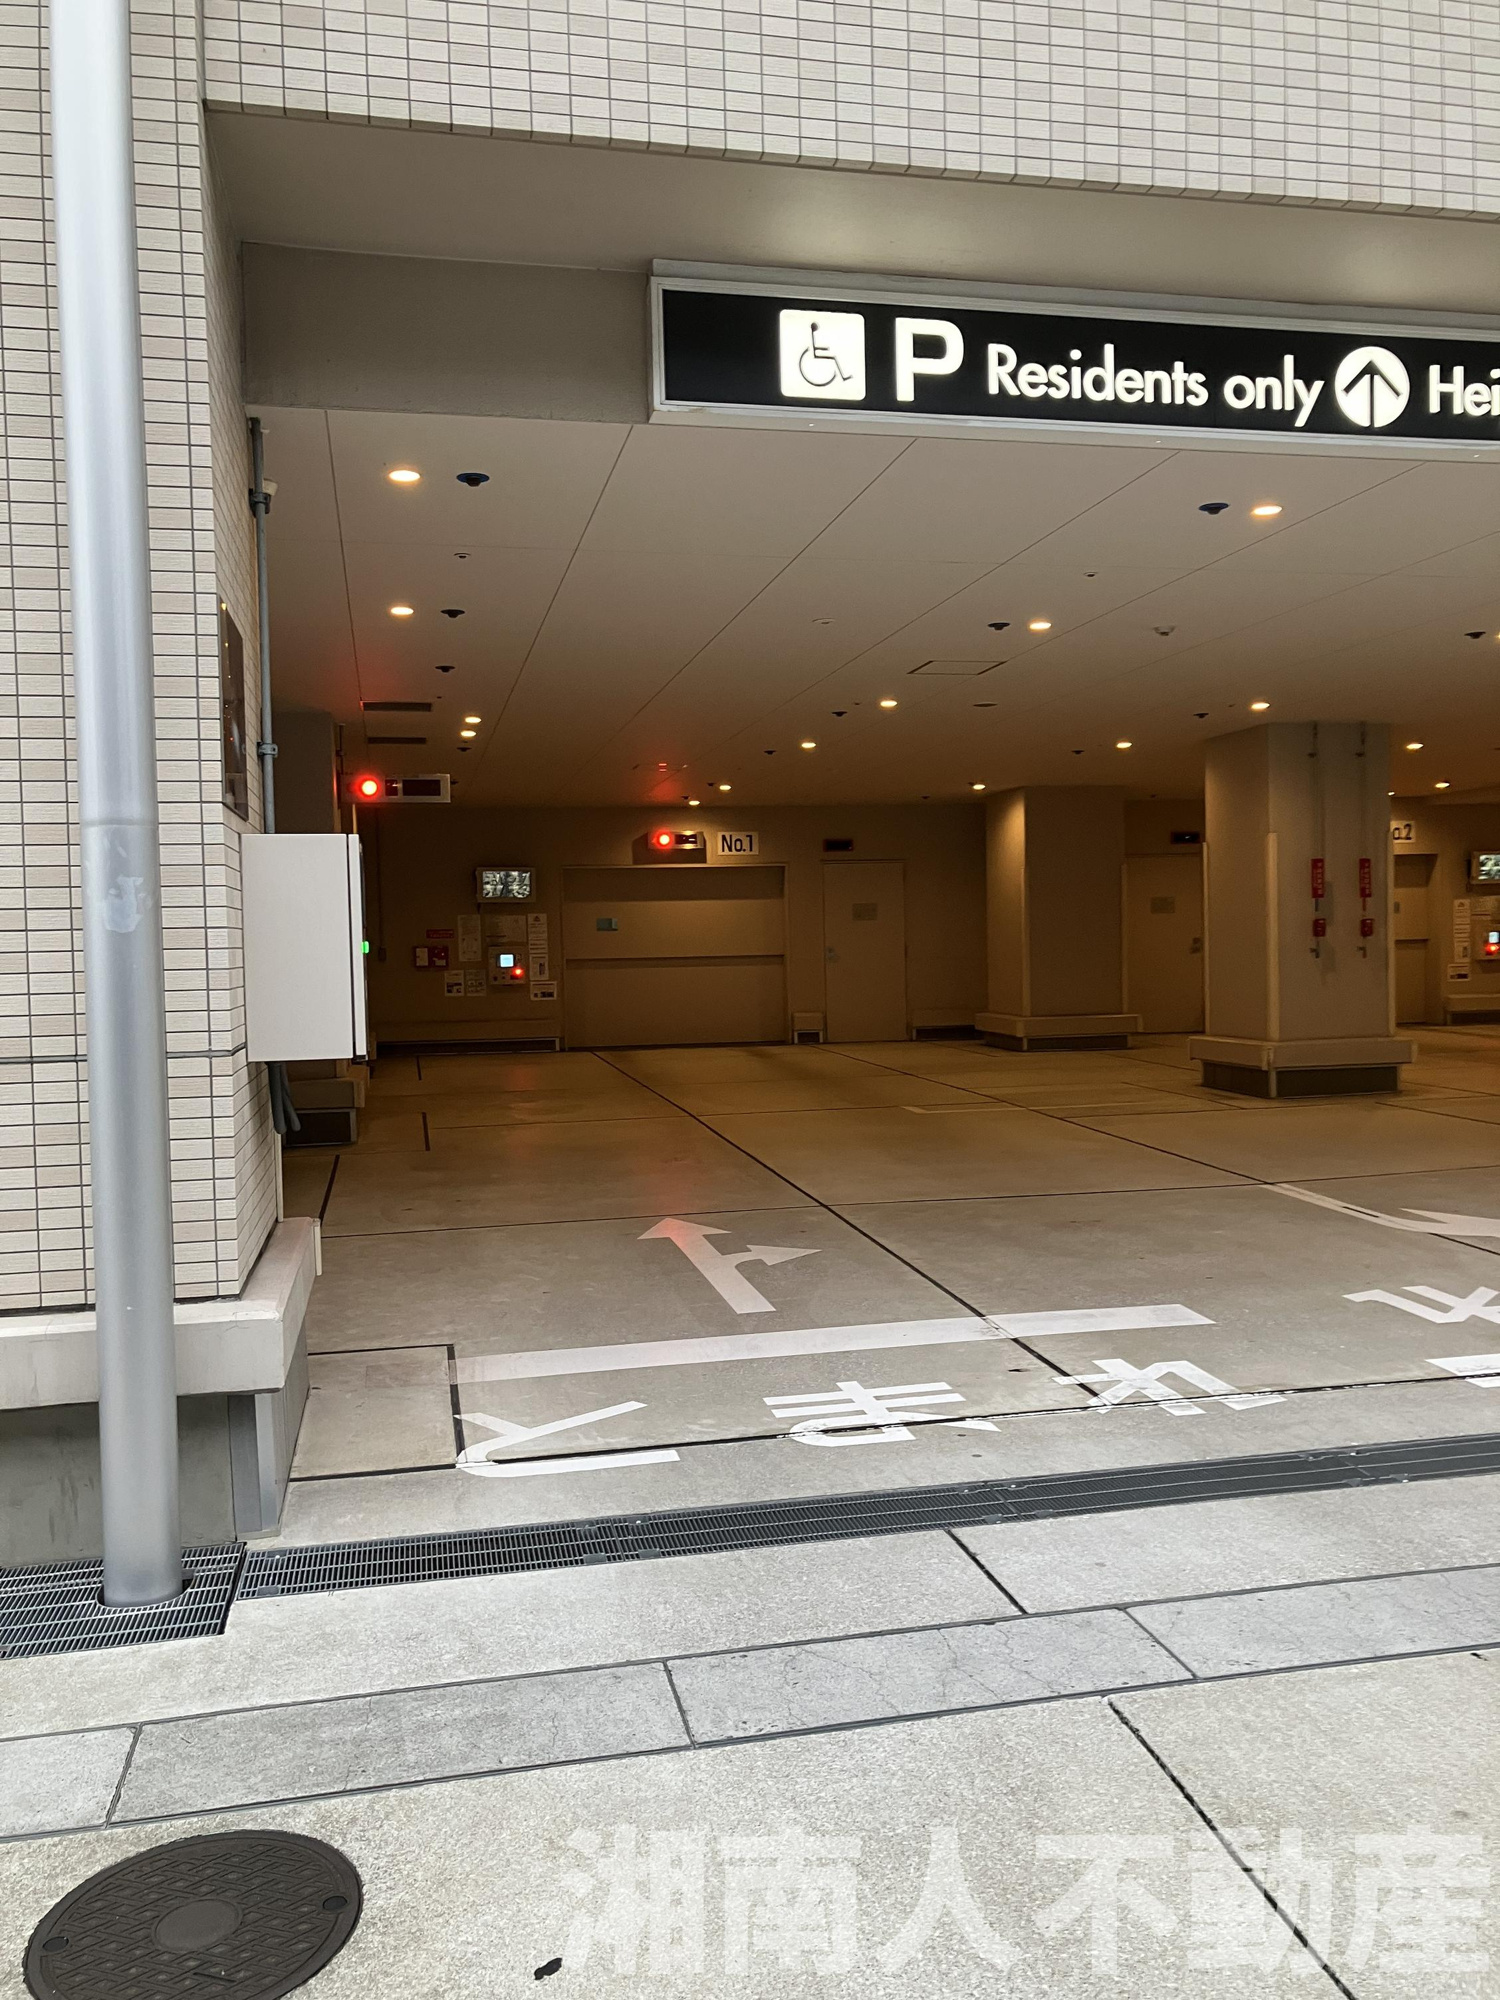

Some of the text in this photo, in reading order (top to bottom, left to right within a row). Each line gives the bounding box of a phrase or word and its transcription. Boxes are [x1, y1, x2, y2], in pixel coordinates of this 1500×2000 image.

[895, 318, 965, 402] P
[988, 343, 1208, 407] Residents
[1224, 354, 1325, 428] only
[721, 833, 754, 853] No.1
[453, 1358, 1287, 1478] とまれ
